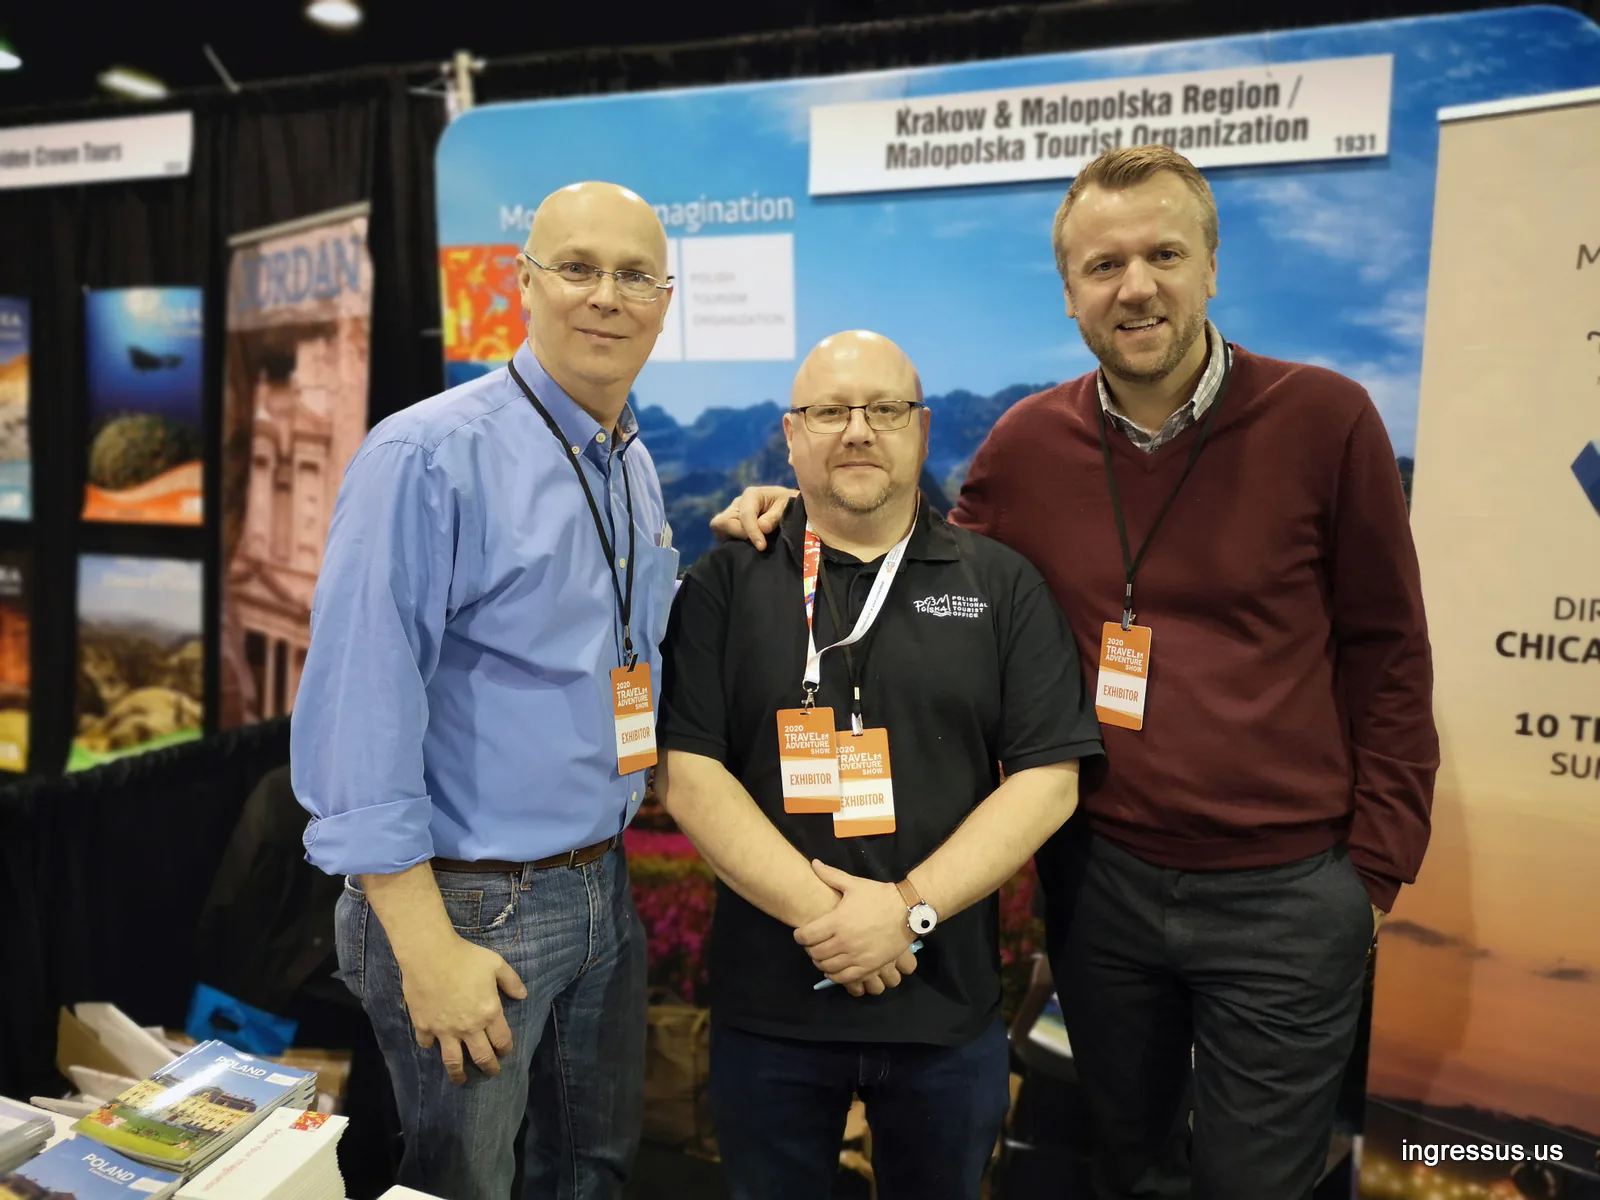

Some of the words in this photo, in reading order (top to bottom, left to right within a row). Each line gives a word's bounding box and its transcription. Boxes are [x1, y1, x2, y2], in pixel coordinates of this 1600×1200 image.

[895, 105, 987, 137] Krakow
[994, 100, 1012, 129] &
[1021, 88, 1172, 127] Malopolska
[1182, 80, 1280, 115] Region
[1288, 75, 1303, 110] /
[885, 135, 1025, 170] Malopolska
[1034, 126, 1123, 160] Tourist
[1131, 115, 1308, 151] Organization
[1335, 134, 1376, 154] 1931
[652, 192, 794, 234] magination
[236, 235, 362, 311] JORDAN
[952, 600, 988, 608] NATIONAL
[1554, 596, 1600, 622] DIR
[1107, 637, 1124, 647] 2020
[1495, 631, 1600, 664] CHICA
[1105, 654, 1143, 667] ADVENTURE
[1125, 664, 1143, 673] SHOW
[617, 681, 630, 690] 2020
[1103, 685, 1139, 702] EXHIBITOR
[618, 694, 648, 707] ADVENTURE
[635, 702, 649, 710] SHOW
[784, 725, 804, 733] 2020
[1515, 712, 1559, 739] 10
[621, 727, 650, 744] EXHIBITOR
[786, 740, 830, 750] ADVENTURE
[790, 773, 832, 785] EXHIBITOR
[840, 793, 884, 808] EXHIBITOR
[214, 1055, 268, 1078] POLAND
[81, 1153, 136, 1183] POLAND
